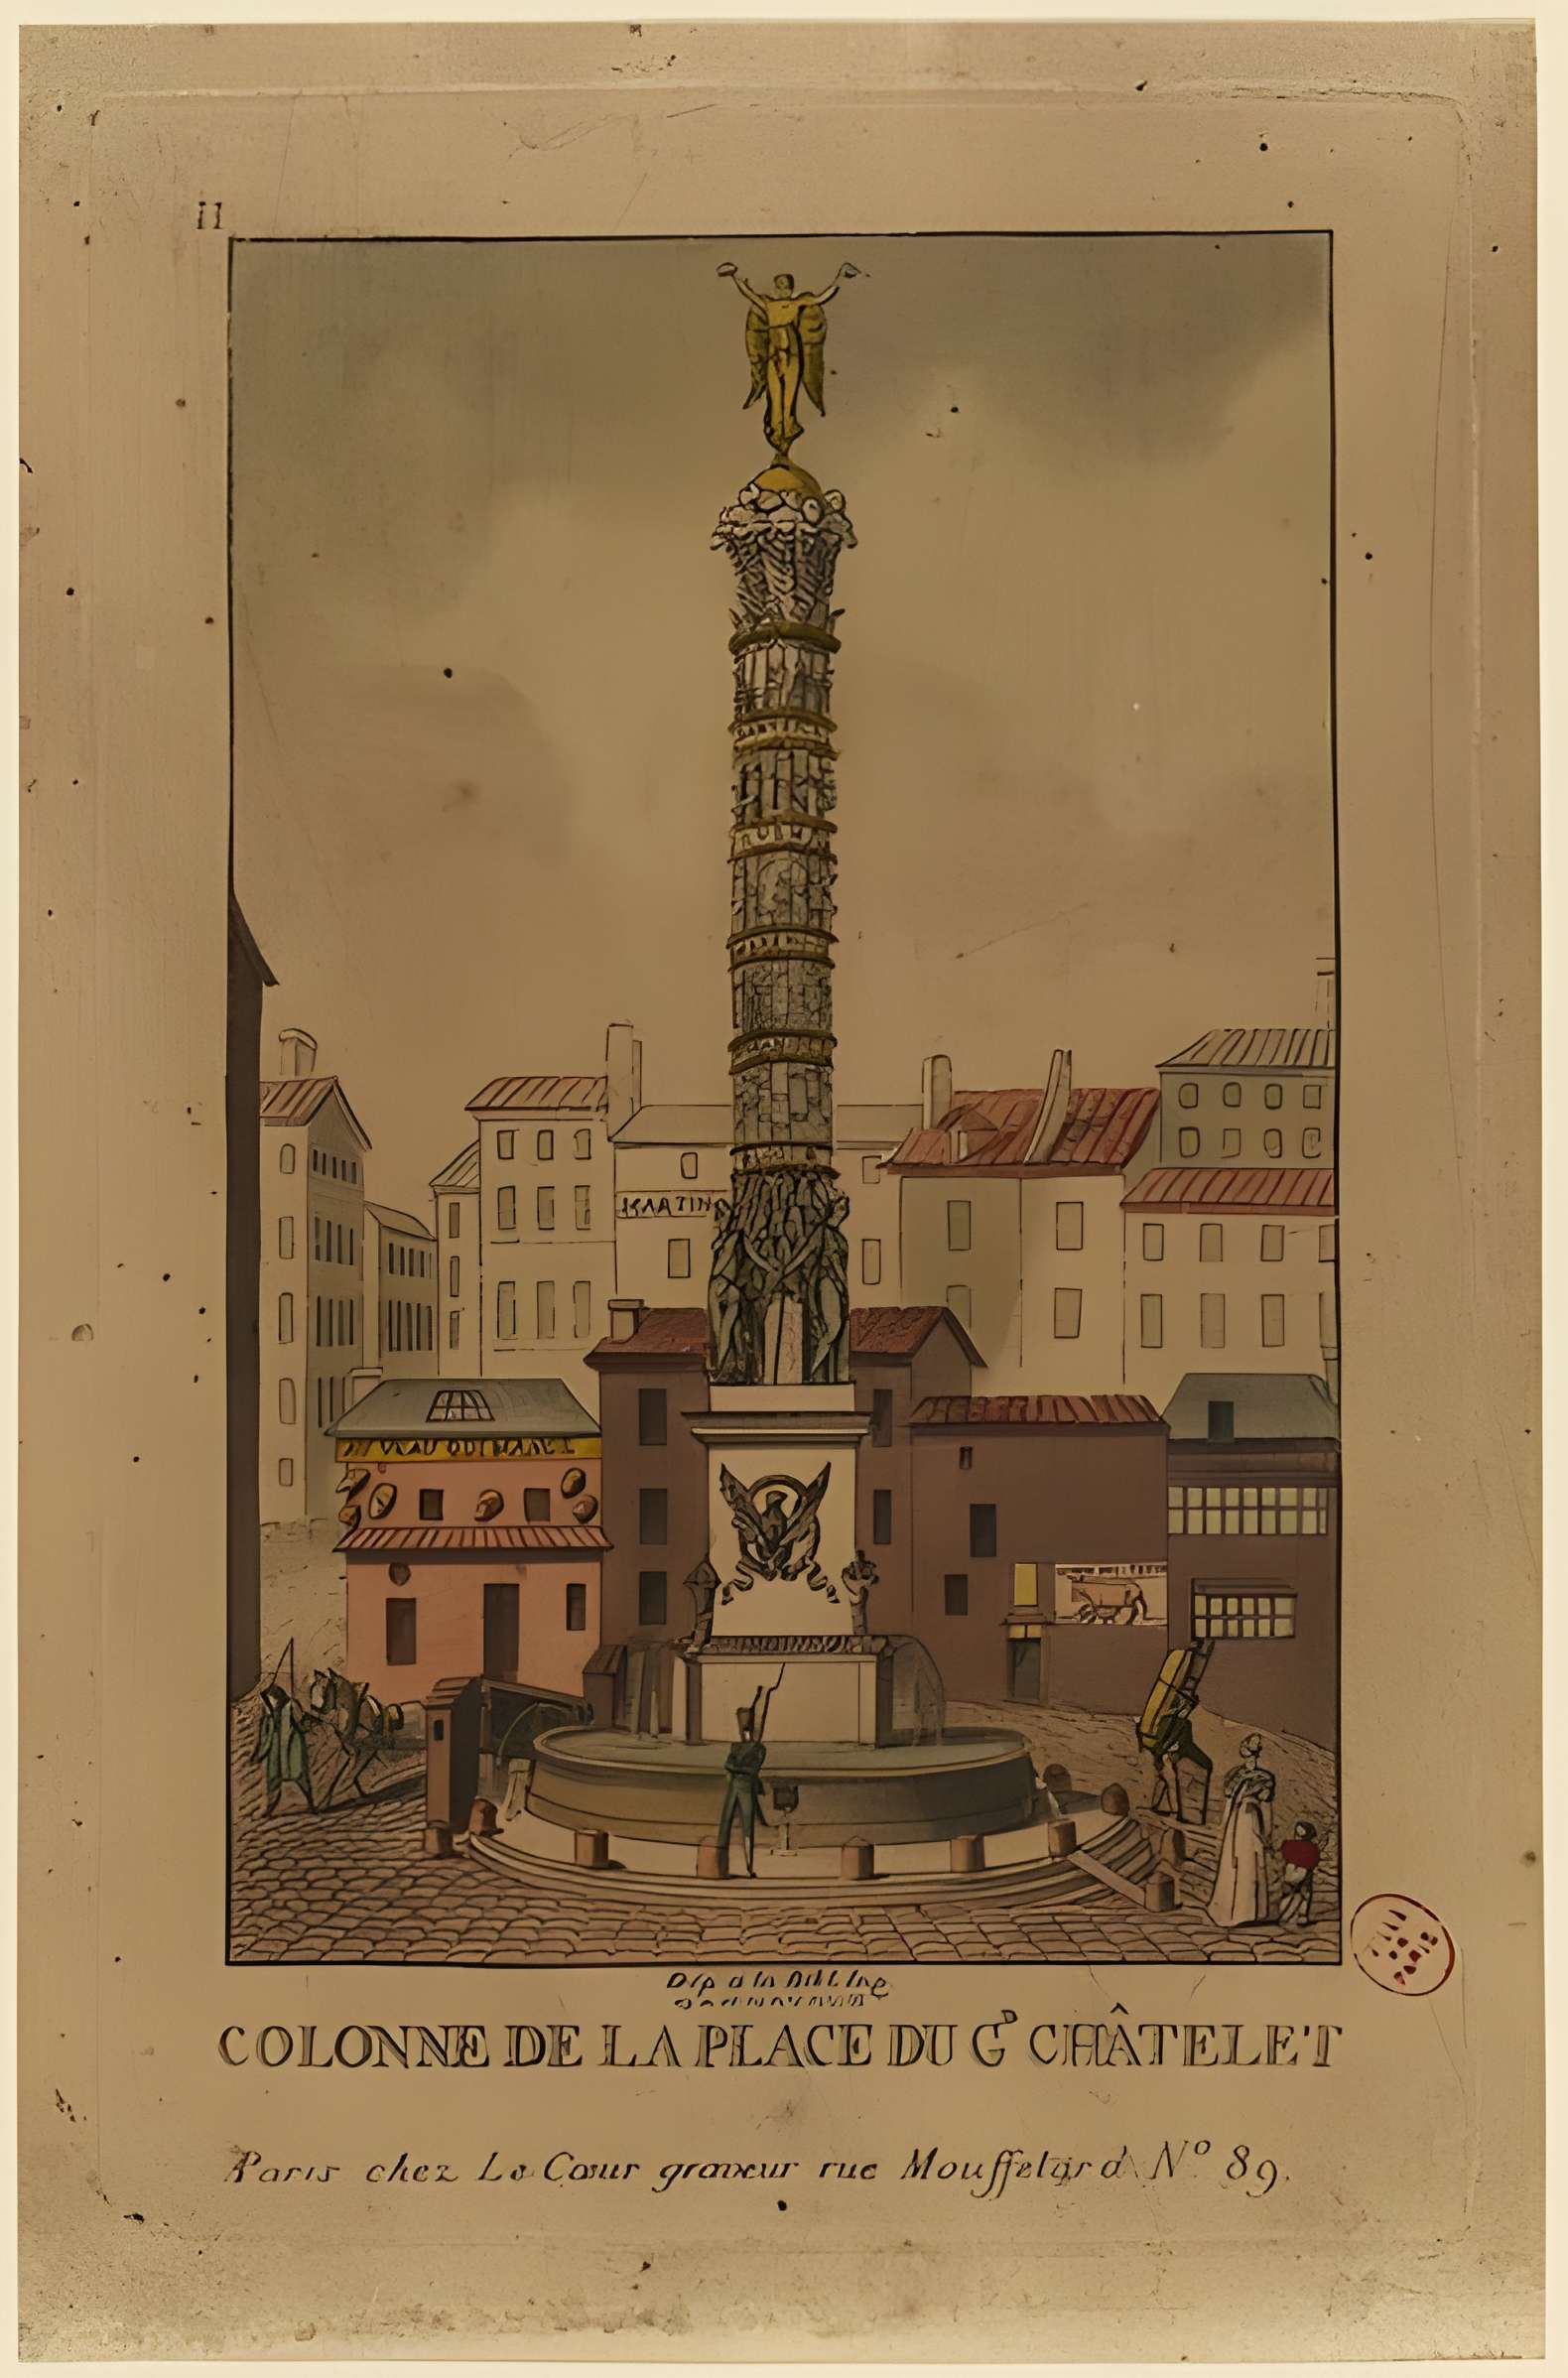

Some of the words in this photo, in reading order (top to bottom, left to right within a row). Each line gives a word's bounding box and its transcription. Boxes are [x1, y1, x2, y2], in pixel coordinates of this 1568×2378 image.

[217, 2025, 490, 2067] COLONNE
[503, 2025, 584, 2067] DE
[597, 2025, 683, 2067] LA
[694, 2024, 873, 2067] PLACE
[886, 2024, 959, 2067] DU
[223, 2150, 341, 2183] Paris
[365, 2152, 459, 2182] chez
[818, 2162, 878, 2181] rue
